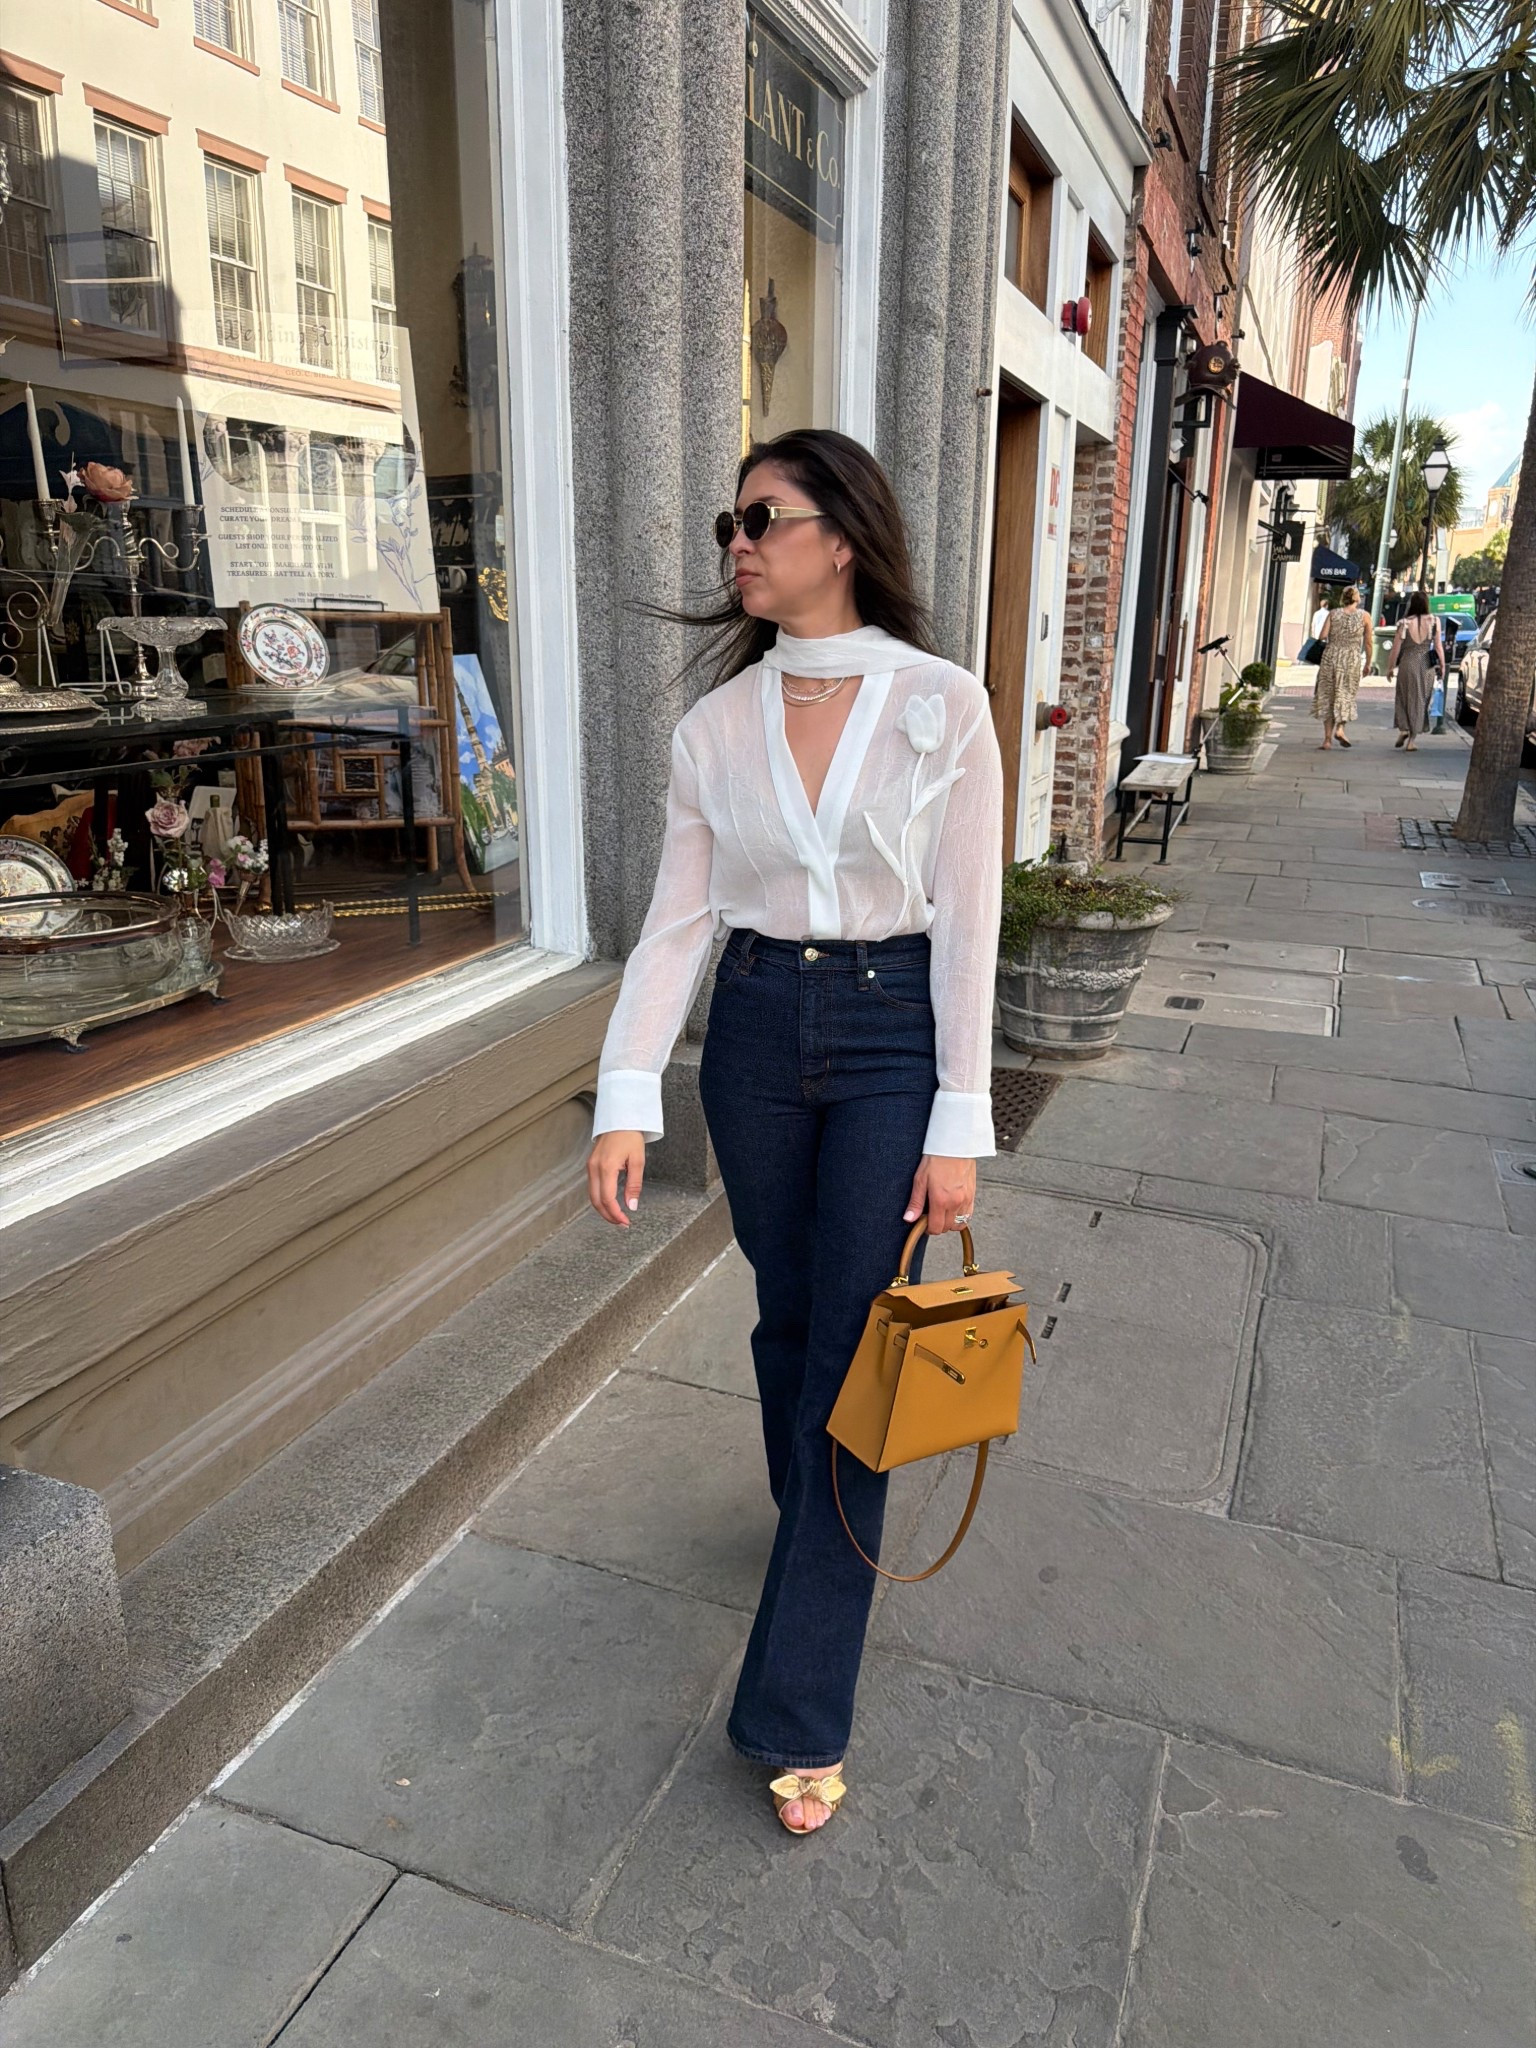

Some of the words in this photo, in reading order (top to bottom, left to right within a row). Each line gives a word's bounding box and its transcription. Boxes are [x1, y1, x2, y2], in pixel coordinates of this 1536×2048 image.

[214, 318, 306, 352] Weding
[310, 324, 392, 360] Rgisty
[1320, 567, 1333, 576] COS
[1334, 568, 1347, 577] BAR
